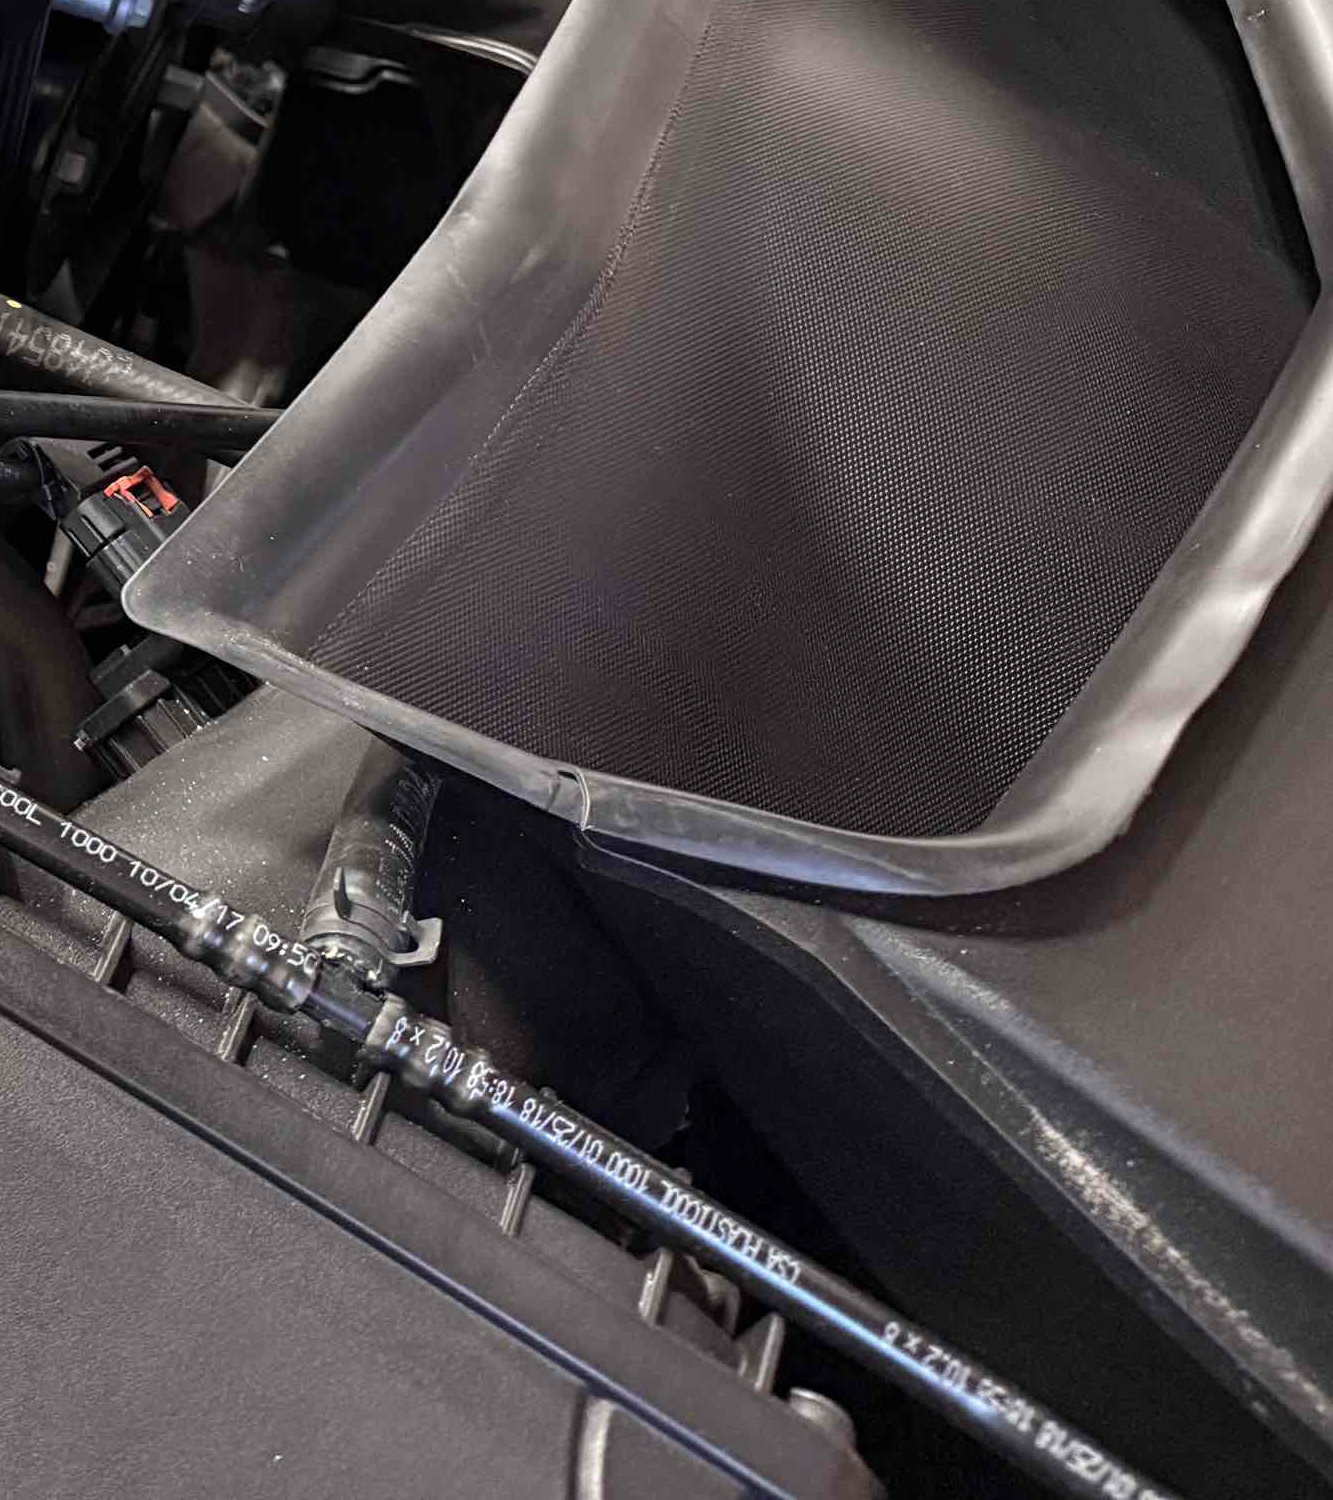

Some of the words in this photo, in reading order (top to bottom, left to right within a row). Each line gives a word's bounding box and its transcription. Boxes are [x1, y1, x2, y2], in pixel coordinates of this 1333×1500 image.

[60, 820, 117, 863] 1000
[130, 860, 245, 930] 10/04/17
[253, 924, 318, 974] 09:50
[386, 1016, 407, 1048] 8
[410, 1025, 426, 1046] x
[520, 1098, 603, 1165] 01/25/18
[605, 1152, 652, 1192] 1000
